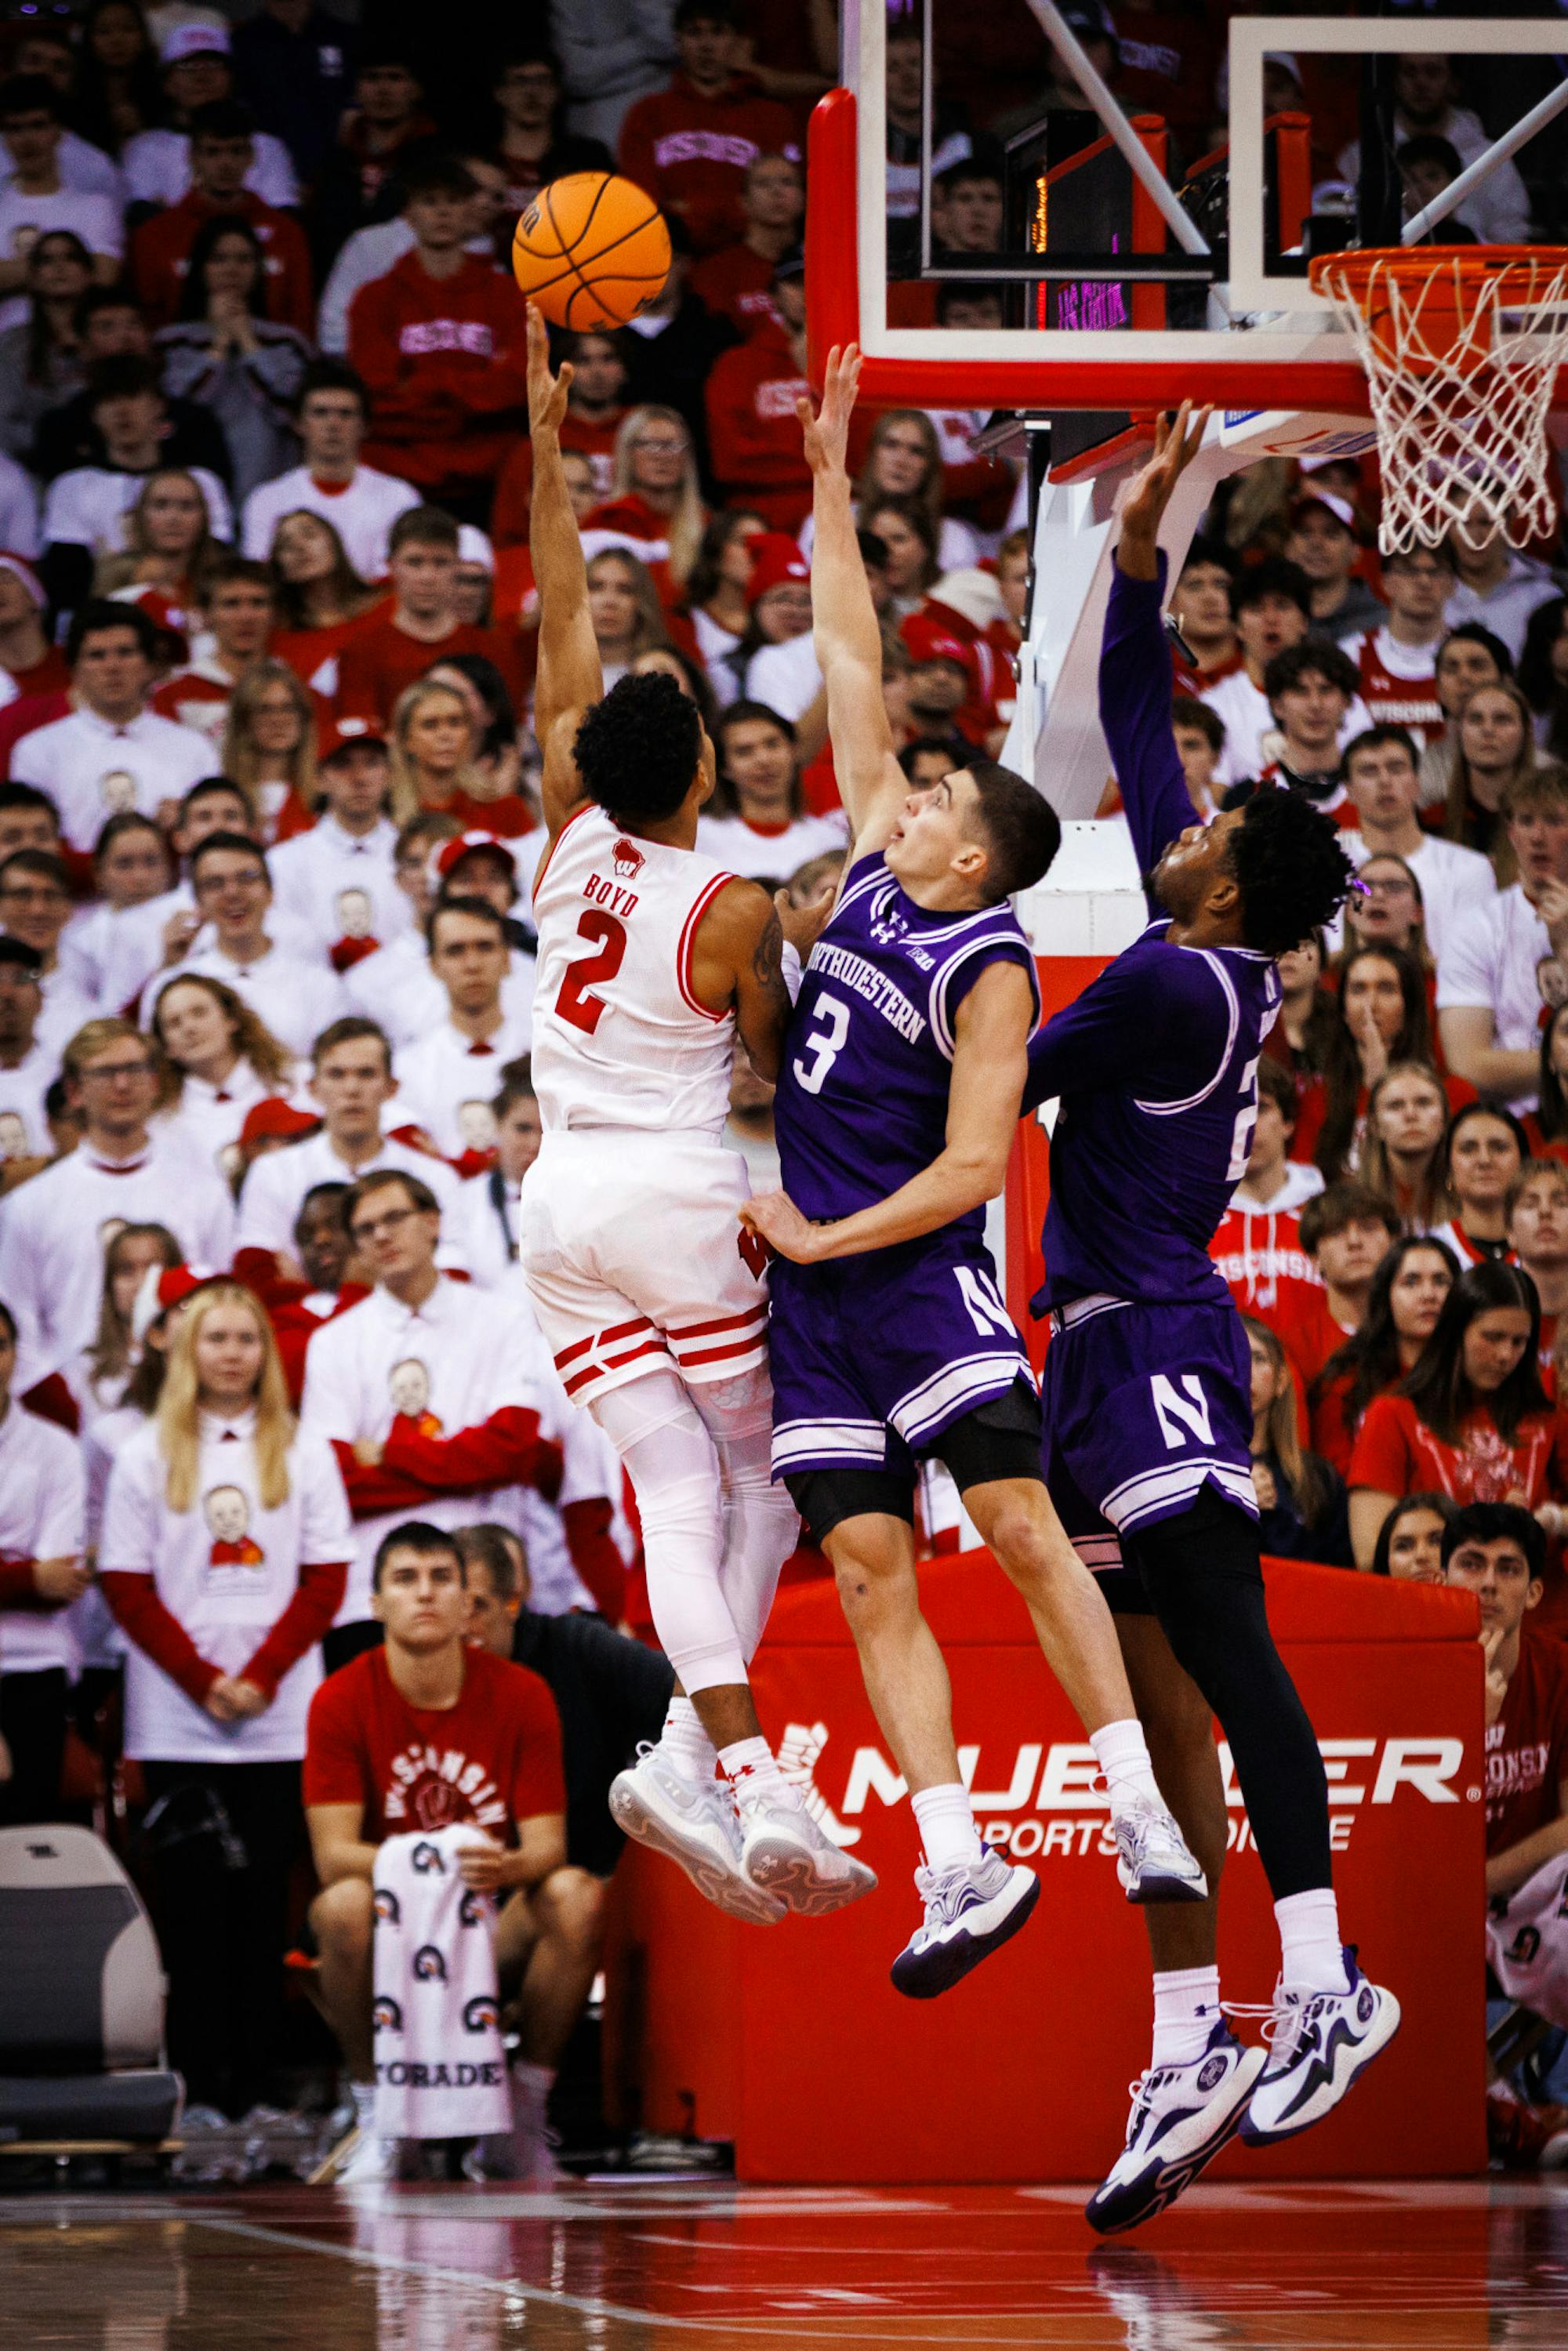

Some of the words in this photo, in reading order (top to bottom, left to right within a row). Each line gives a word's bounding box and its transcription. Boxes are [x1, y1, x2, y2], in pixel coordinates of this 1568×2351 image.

[583, 873, 639, 918] BOYD
[554, 909, 626, 1035] 2
[793, 991, 851, 1094] 3
[1212, 1250, 1327, 1285] ISCONSI
[953, 1265, 1018, 1339] N
[1149, 1373, 1216, 1449] N
[975, 1819, 1119, 1858] PORTS
[376, 2063, 502, 2087] ORADE
